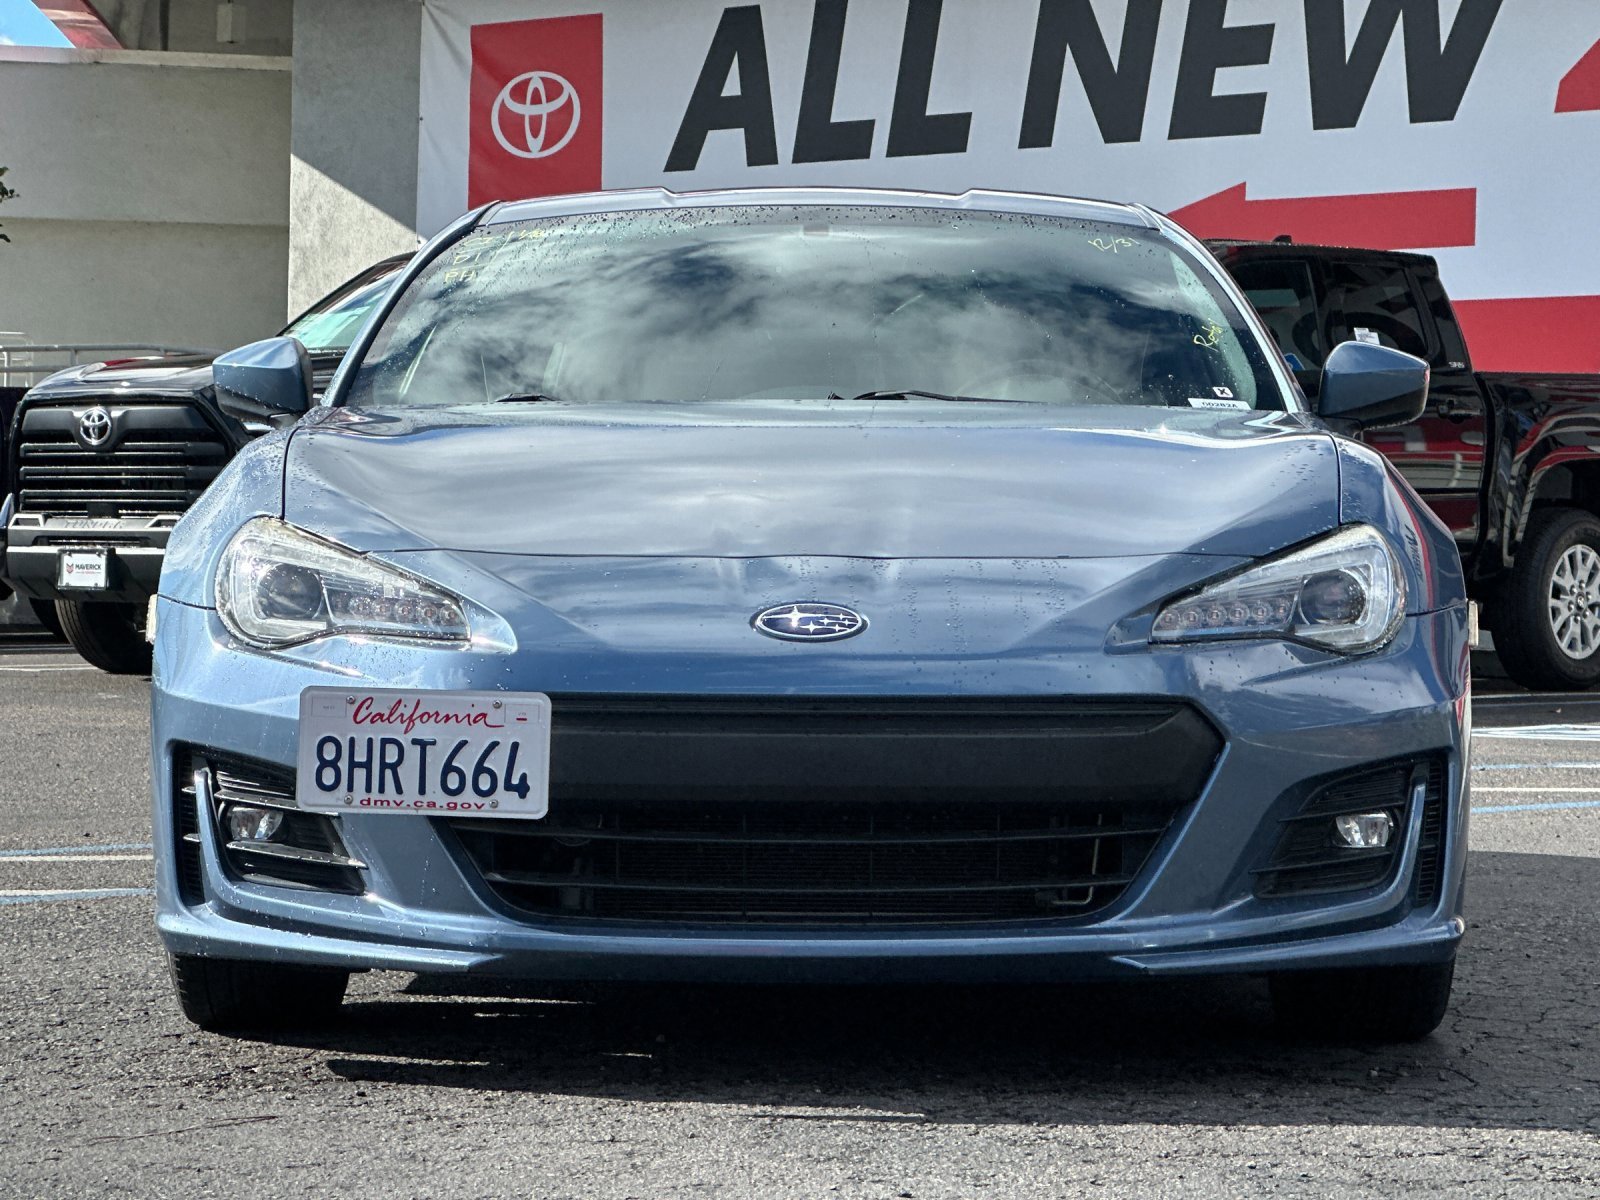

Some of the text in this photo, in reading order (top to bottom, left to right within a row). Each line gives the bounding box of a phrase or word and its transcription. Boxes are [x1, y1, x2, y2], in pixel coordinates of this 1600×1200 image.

[663, 0, 972, 172] ALL
[1018, 0, 1504, 149] NEW
[352, 696, 505, 734] California
[315, 735, 531, 800] 8HRT664
[359, 797, 487, 811] dmv.ca.gov
